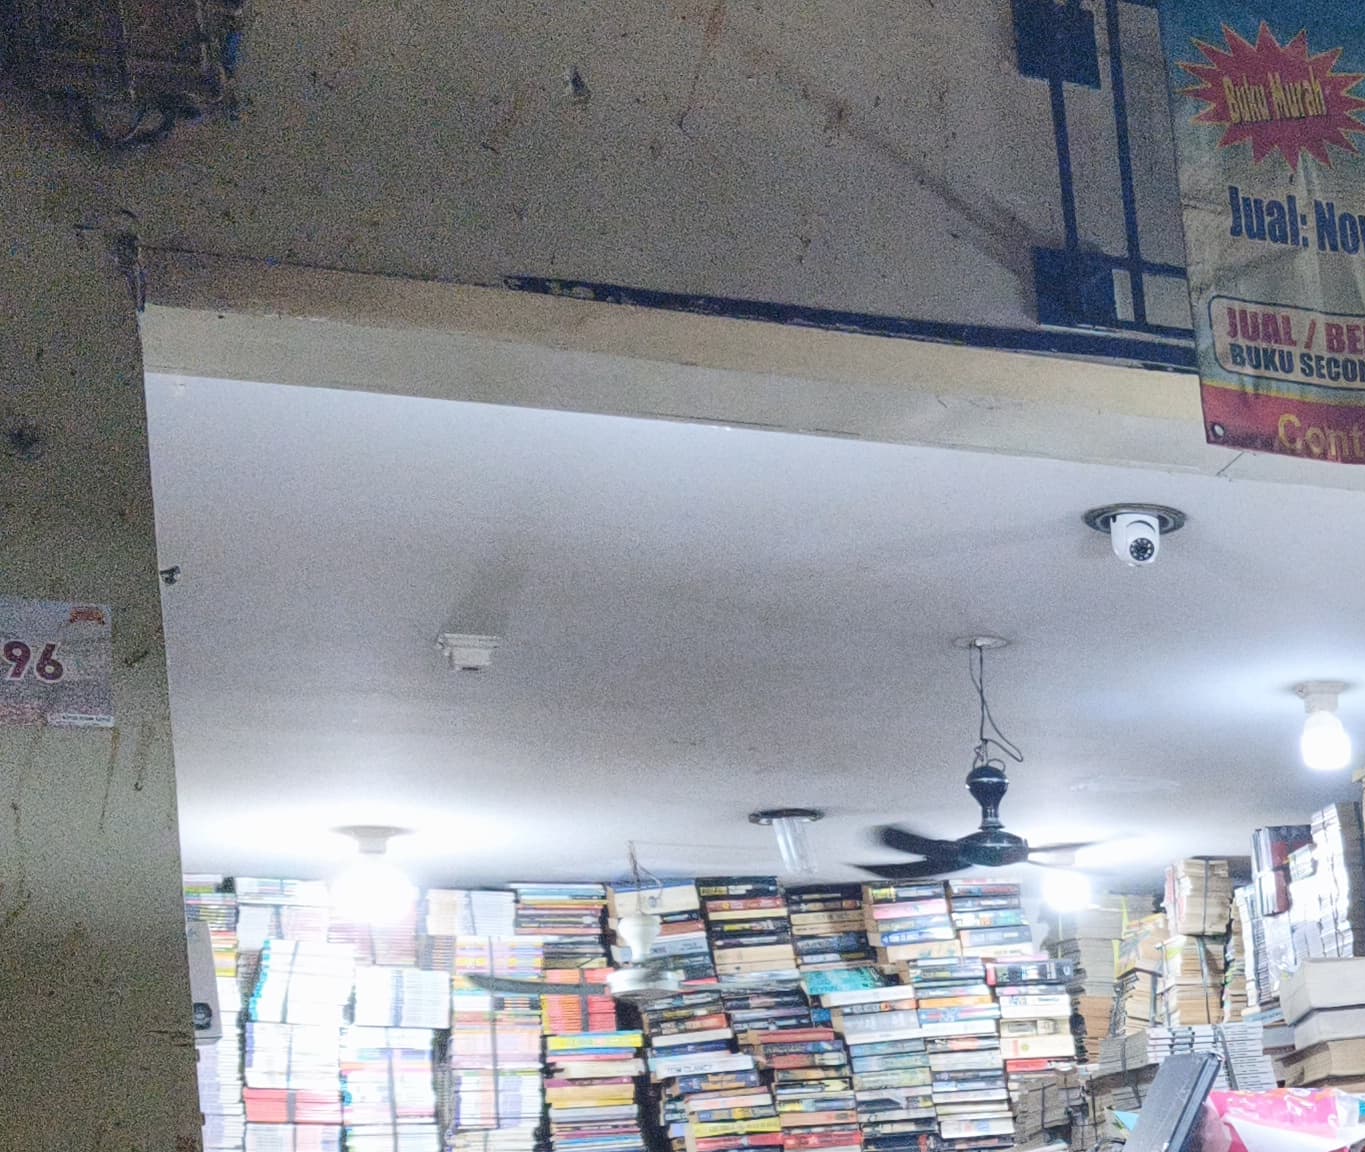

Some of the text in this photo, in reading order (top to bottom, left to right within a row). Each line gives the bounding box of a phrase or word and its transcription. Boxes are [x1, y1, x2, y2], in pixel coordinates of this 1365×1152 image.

[1222, 70, 1327, 121] Buku Murah
[1228, 186, 1309, 248] Jual:
[1227, 307, 1296, 347] JUAL
[1303, 319, 1316, 349] /
[1230, 343, 1294, 374] BUKU
[3, 640, 64, 683] 96
